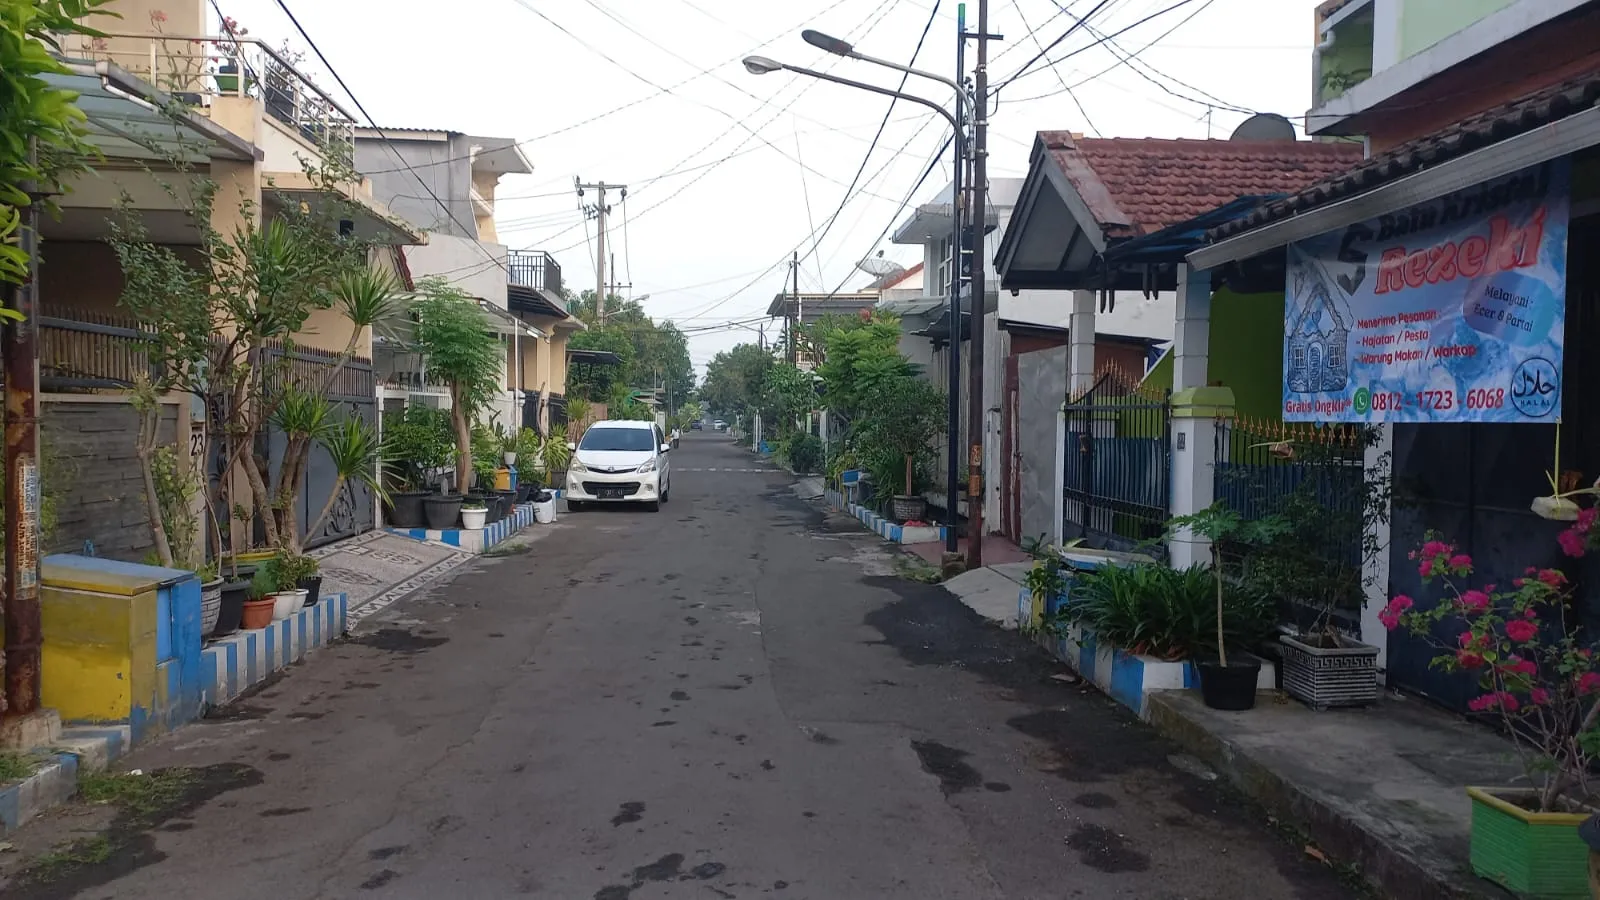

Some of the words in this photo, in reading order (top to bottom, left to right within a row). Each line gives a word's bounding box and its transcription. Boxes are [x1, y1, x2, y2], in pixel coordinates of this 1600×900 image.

[1484, 284, 1529, 308] Melayani
[1357, 315, 1396, 329] Menerima
[1398, 309, 1437, 324] Pesanan
[1473, 302, 1496, 319] Ecer
[1506, 313, 1534, 333] Partai
[1362, 335, 1395, 348] Hajatan
[1397, 332, 1403, 345] /
[1404, 330, 1429, 342] Pesta
[1360, 351, 1393, 365] Warung
[1394, 348, 1423, 362] Makan
[1425, 347, 1431, 361] /
[1432, 344, 1477, 359] Warkop
[1285, 400, 1312, 413] Gratis
[1371, 392, 1403, 411] 0812
[1416, 390, 1453, 410] 1723
[1466, 388, 1504, 409] 6068
[190, 433, 204, 456] 23
